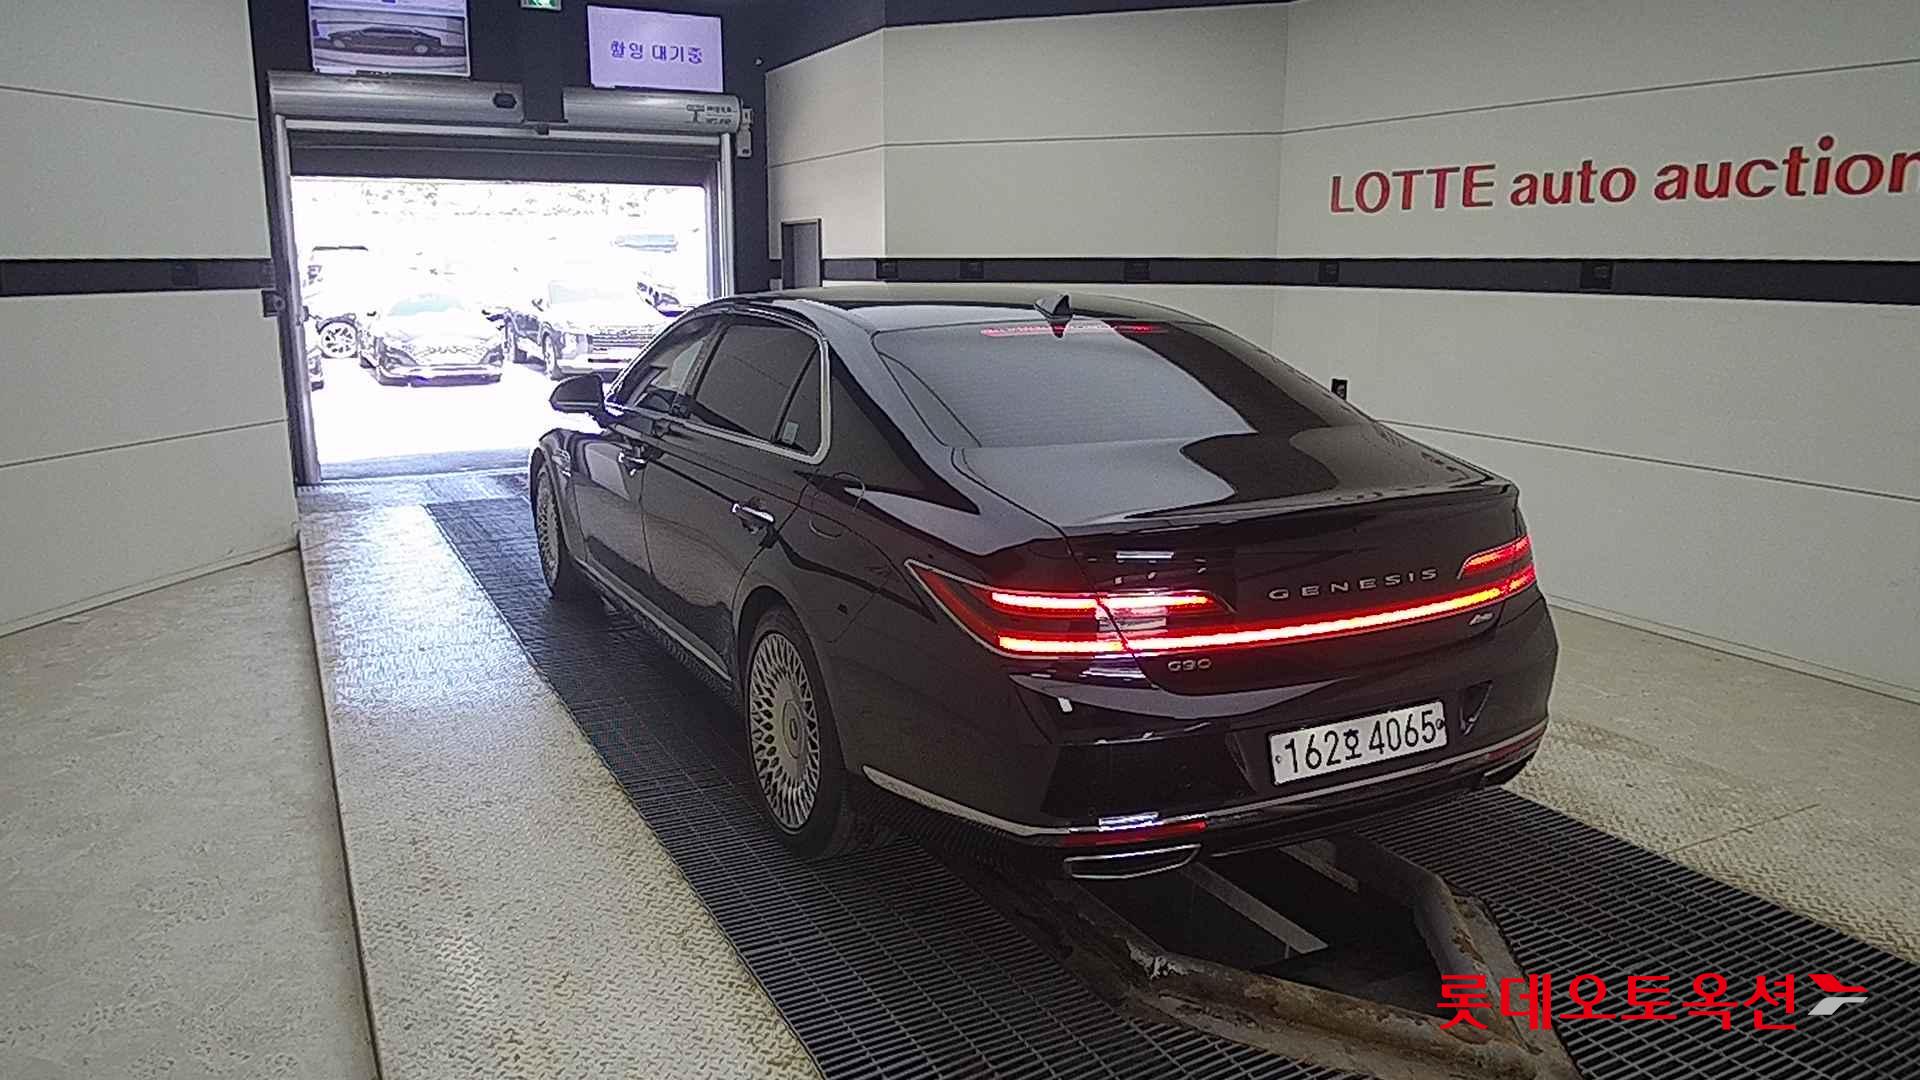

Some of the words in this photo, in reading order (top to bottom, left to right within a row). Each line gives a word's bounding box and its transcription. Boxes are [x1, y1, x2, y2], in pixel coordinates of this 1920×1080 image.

[652, 44, 702, 64] 대기중
[1330, 164, 1496, 214] LOTTE
[1510, 160, 1637, 206] auto
[1268, 568, 1437, 600] GENESIS
[1168, 658, 1211, 671] G90
